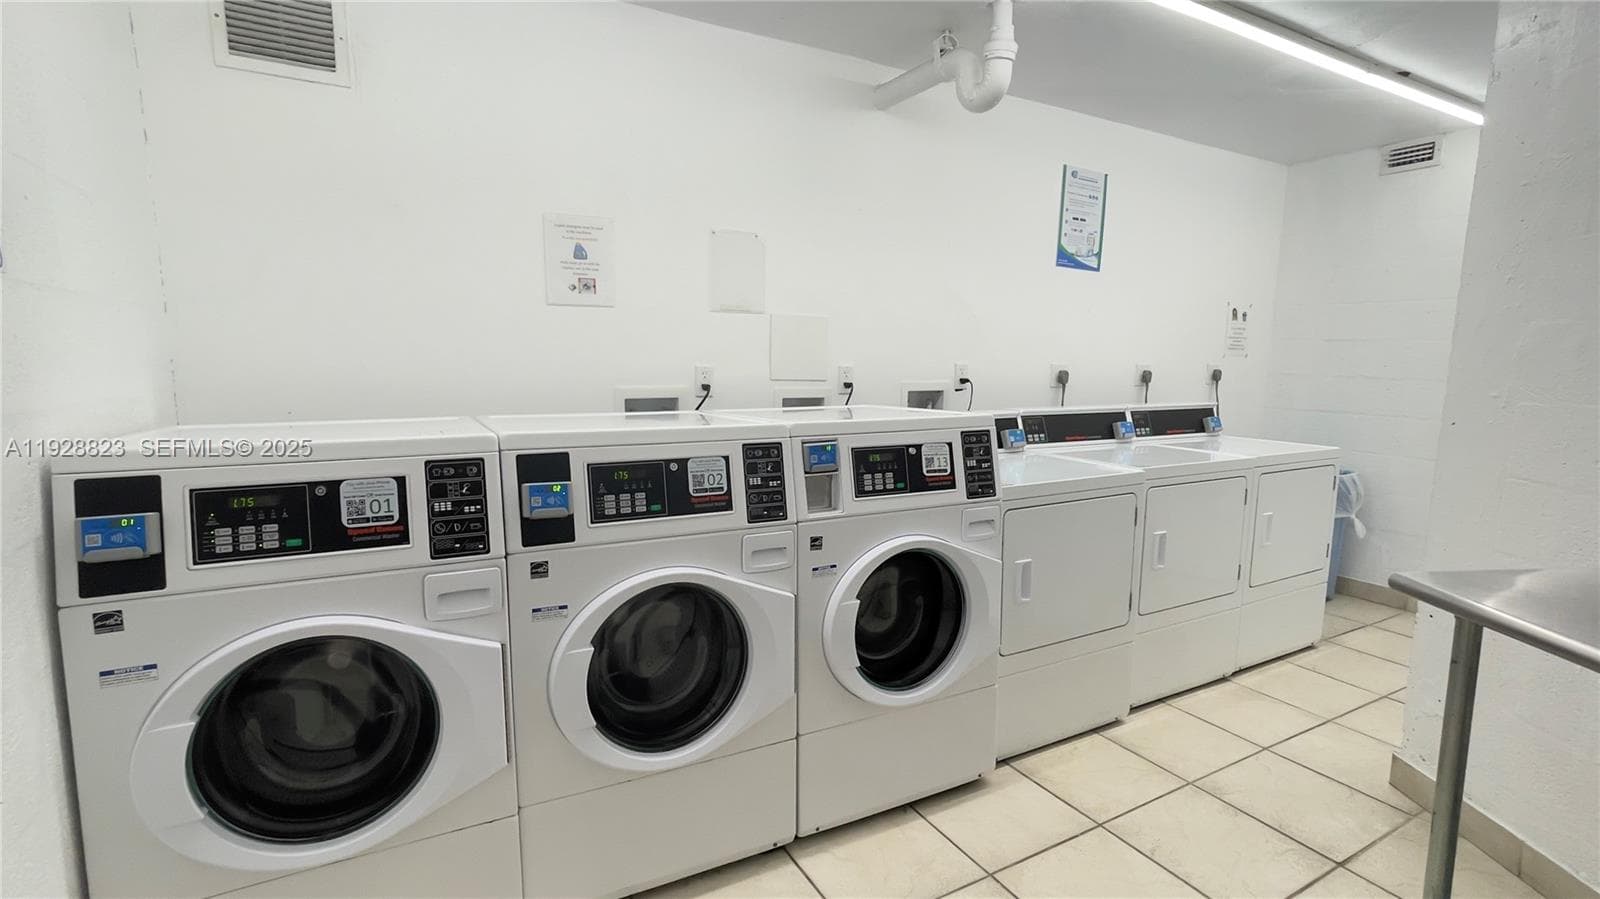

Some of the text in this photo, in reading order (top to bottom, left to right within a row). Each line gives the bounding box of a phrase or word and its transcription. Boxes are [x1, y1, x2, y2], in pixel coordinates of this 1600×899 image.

[936, 456, 949, 468] 13
[707, 472, 724, 486] 02
[369, 498, 394, 515] 01
[121, 518, 134, 527] 01
